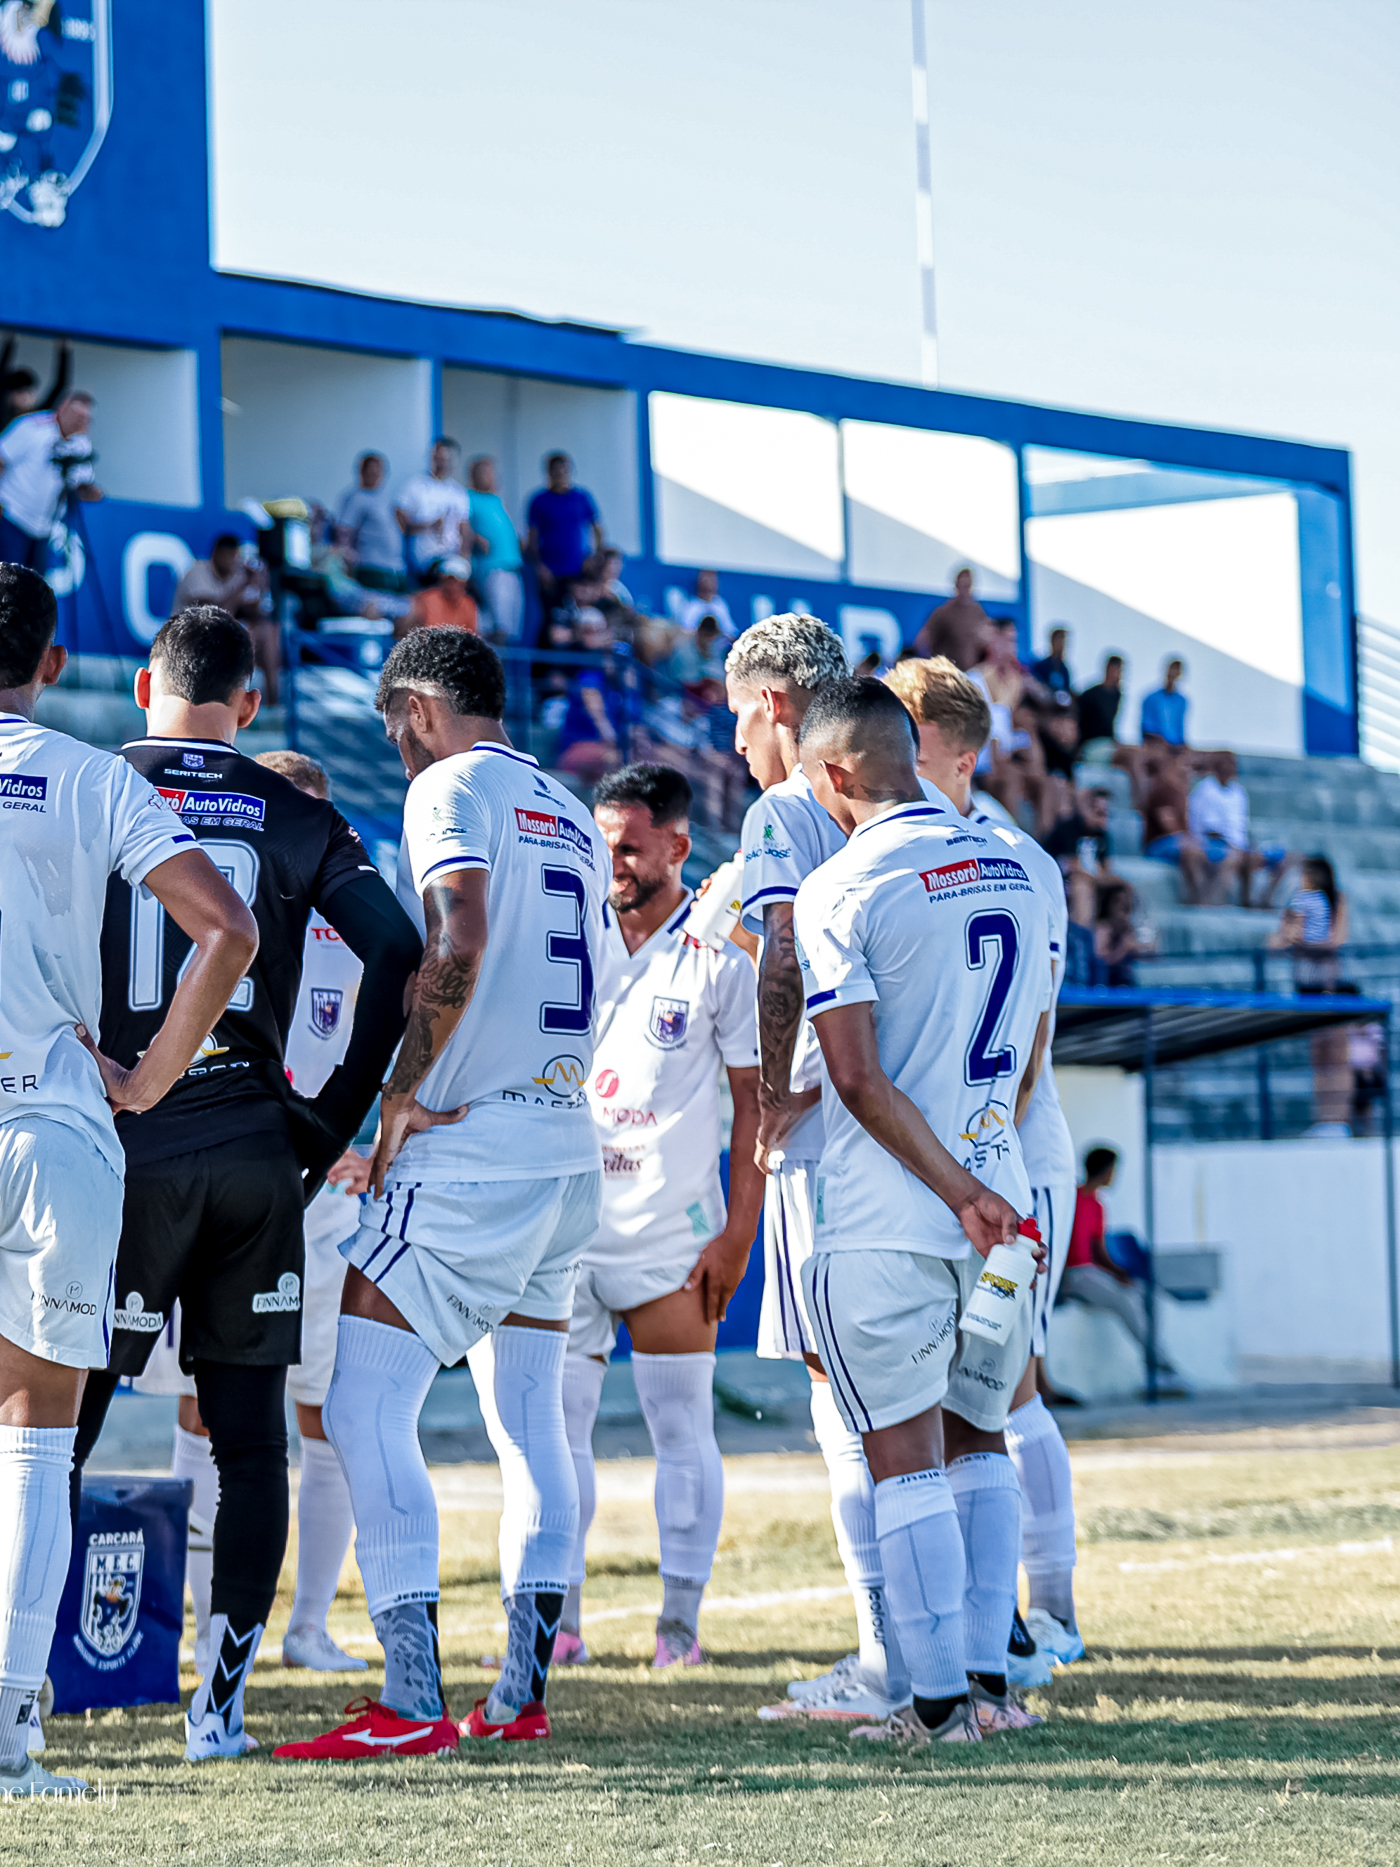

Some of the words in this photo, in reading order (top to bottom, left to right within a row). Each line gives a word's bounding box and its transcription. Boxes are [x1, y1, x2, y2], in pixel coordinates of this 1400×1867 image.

[164, 768, 223, 778] SERITECH
[2, 801, 47, 813] GERAL
[184, 797, 260, 816] AutoVidros
[201, 817, 221, 826] EM
[223, 817, 265, 831] GERAL
[518, 813, 556, 836] Mossoró
[926, 862, 978, 890] Mossoró
[980, 861, 1027, 880] AutoVidros
[994, 884, 1007, 892] EM
[1009, 882, 1035, 894] GERAL
[540, 863, 597, 1037] 3
[964, 908, 1021, 1087] 2
[89, 1527, 144, 1546] CARCARÁ
